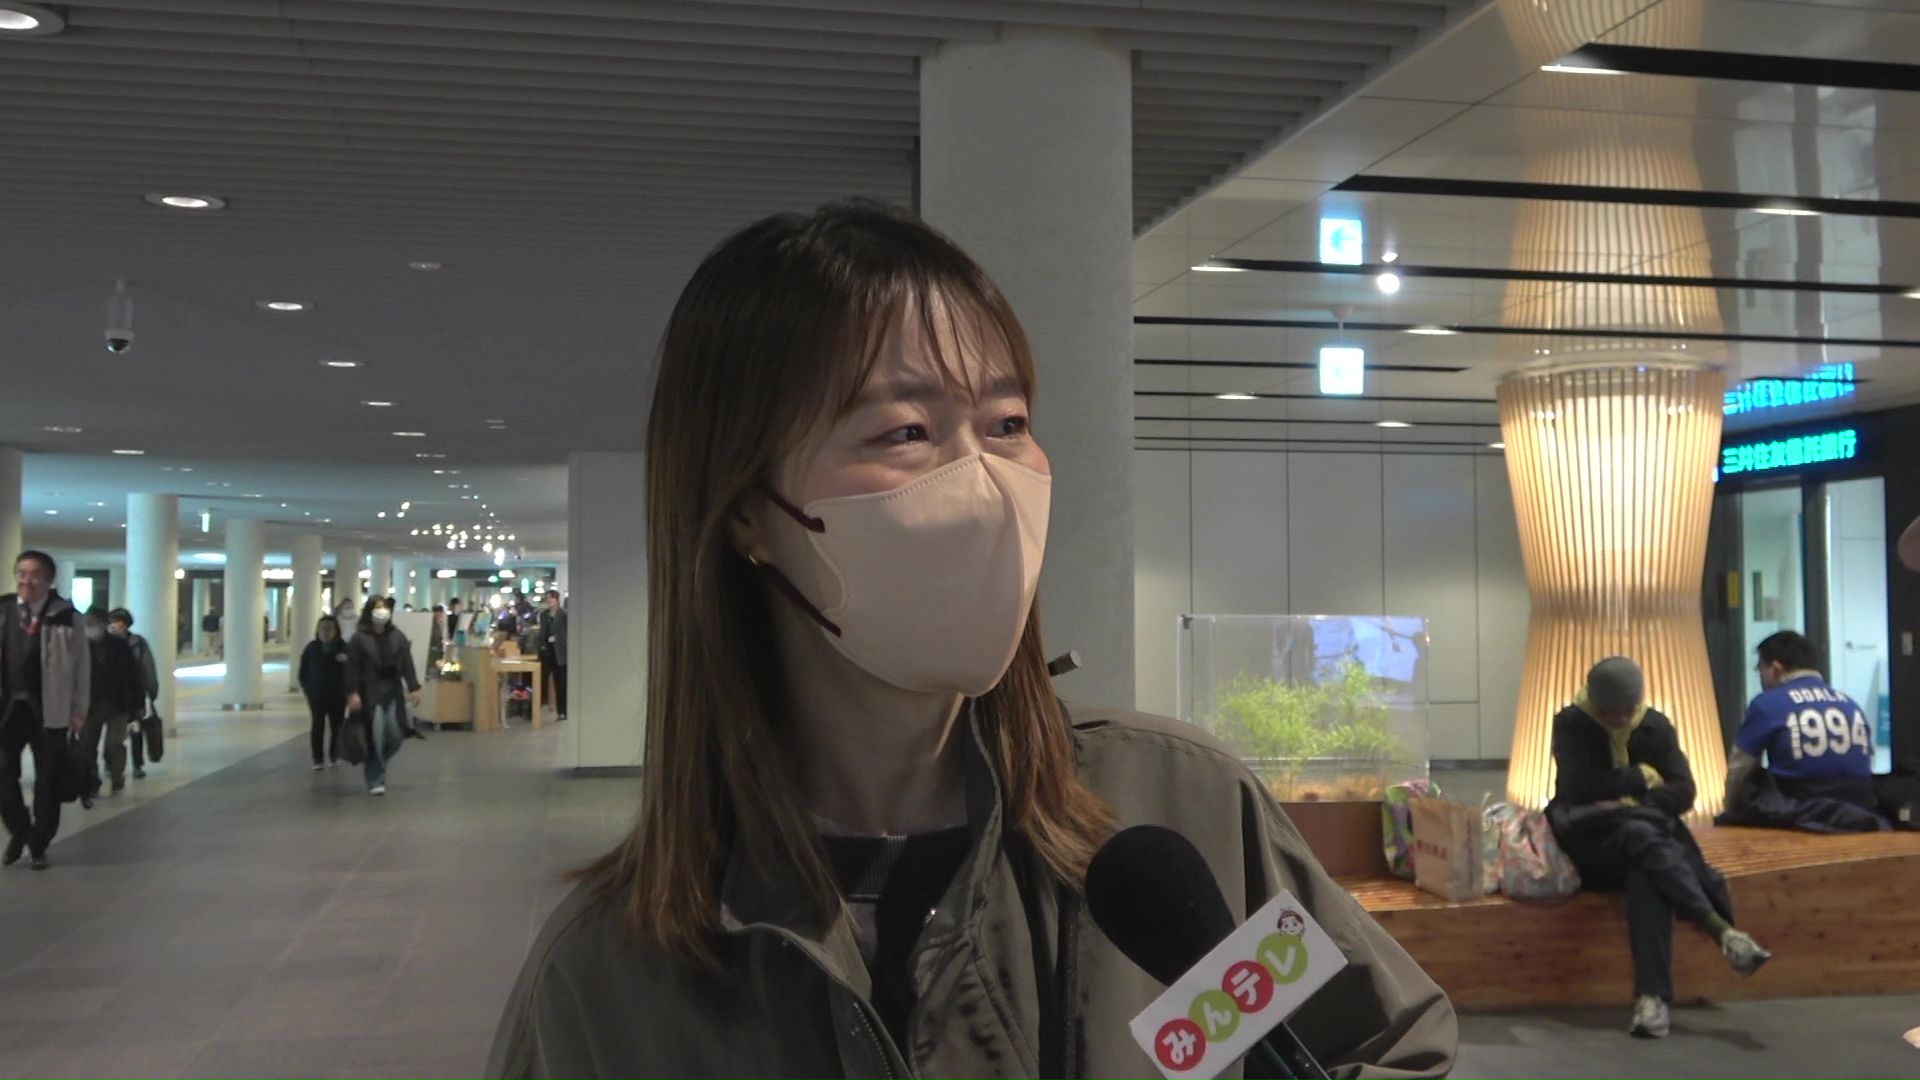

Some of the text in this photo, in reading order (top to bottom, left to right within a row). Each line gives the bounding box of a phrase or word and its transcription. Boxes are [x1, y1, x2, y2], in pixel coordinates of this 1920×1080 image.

[1786, 706, 1869, 760] 1994
[1161, 945, 1297, 1064] みんテレ
